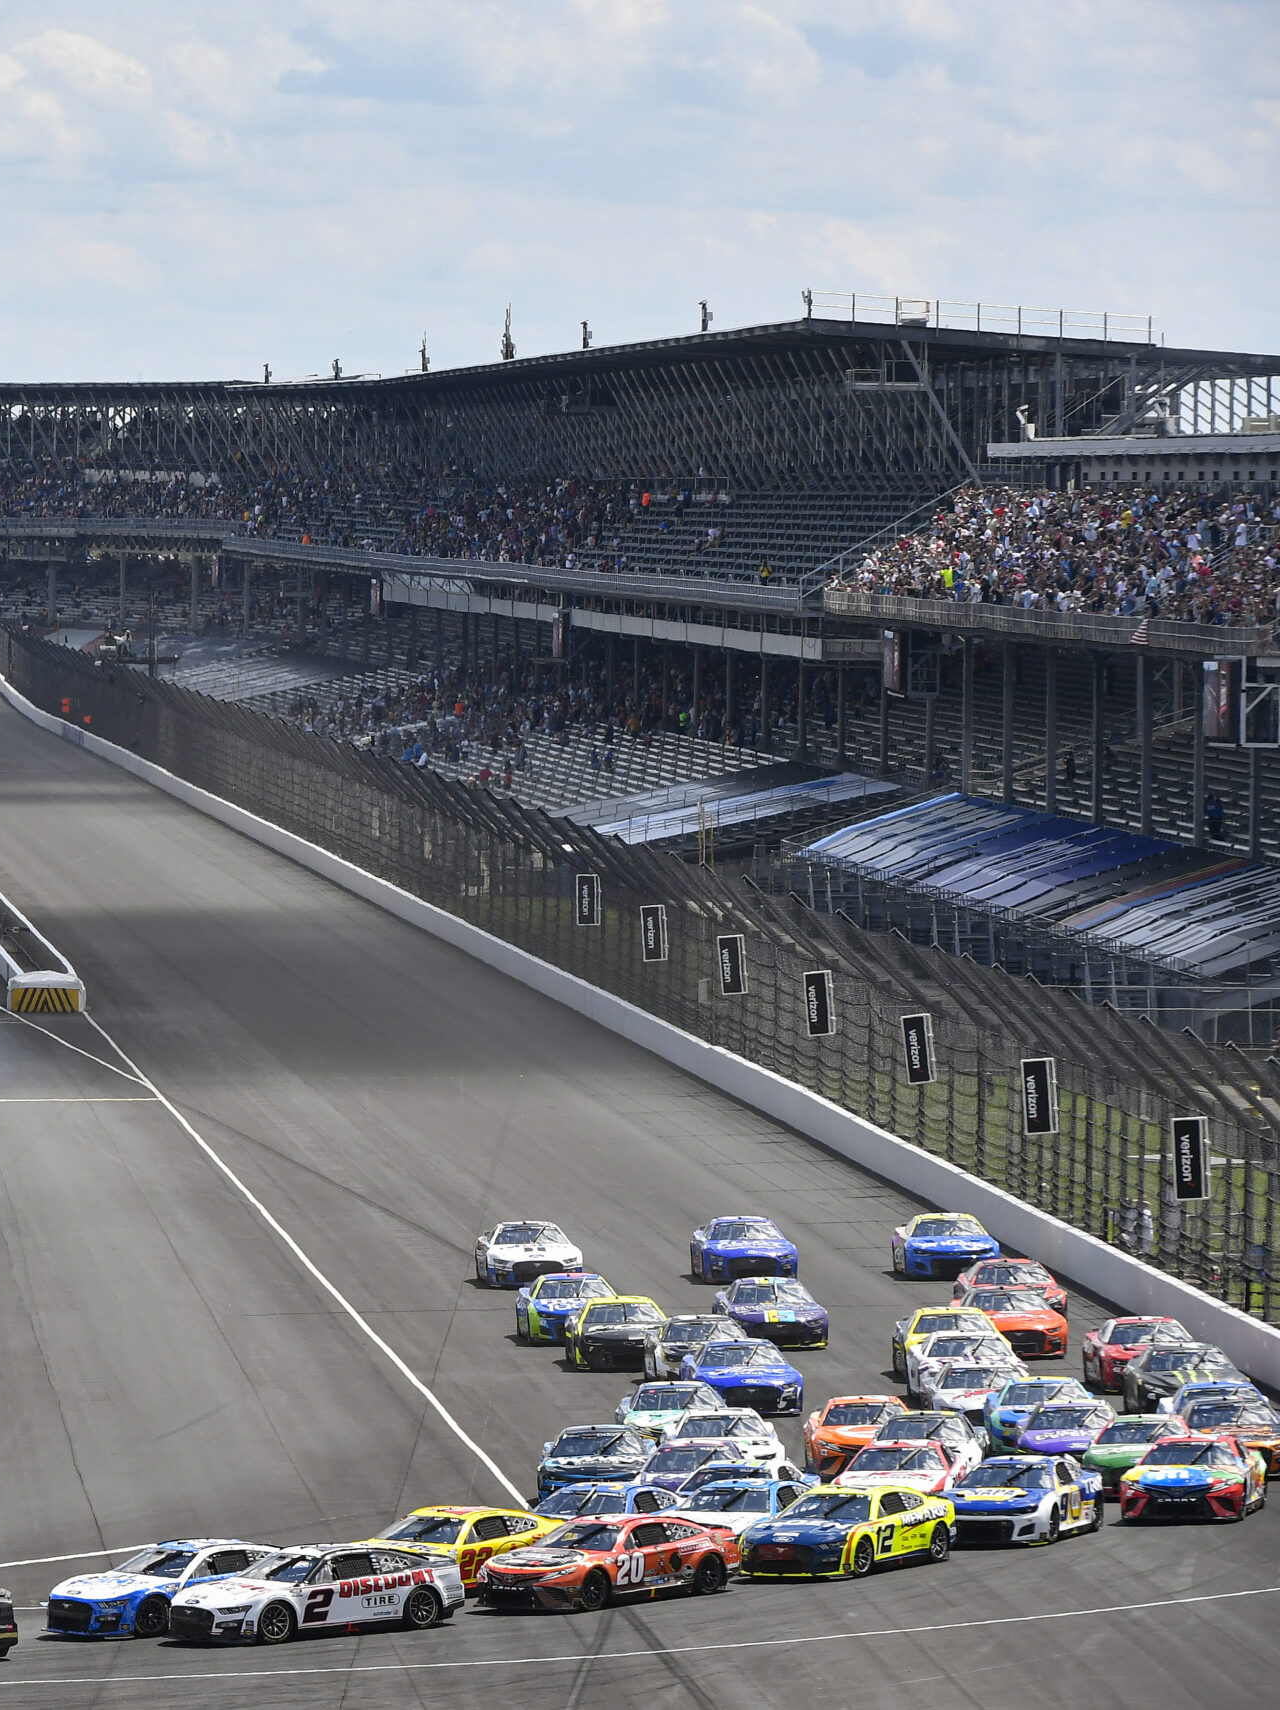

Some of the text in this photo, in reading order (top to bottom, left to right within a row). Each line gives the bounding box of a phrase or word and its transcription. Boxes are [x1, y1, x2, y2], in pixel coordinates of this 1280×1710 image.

[581, 884, 589, 916] verizon
[646, 916, 654, 949] verizon
[721, 948, 731, 983] verizon
[807, 985, 818, 1023] verizon
[908, 1029, 921, 1069] verizon
[1026, 1074, 1037, 1119] verizon
[1179, 1134, 1193, 1182] verizon
[973, 1488, 1016, 1497] NAPA
[875, 1524, 895, 1555] 12
[460, 1547, 493, 1581] 22
[616, 1552, 645, 1586] 20
[339, 1568, 435, 1598] DISCOUNT
[302, 1588, 334, 1624] 2
[365, 1594, 395, 1607] TIRE
